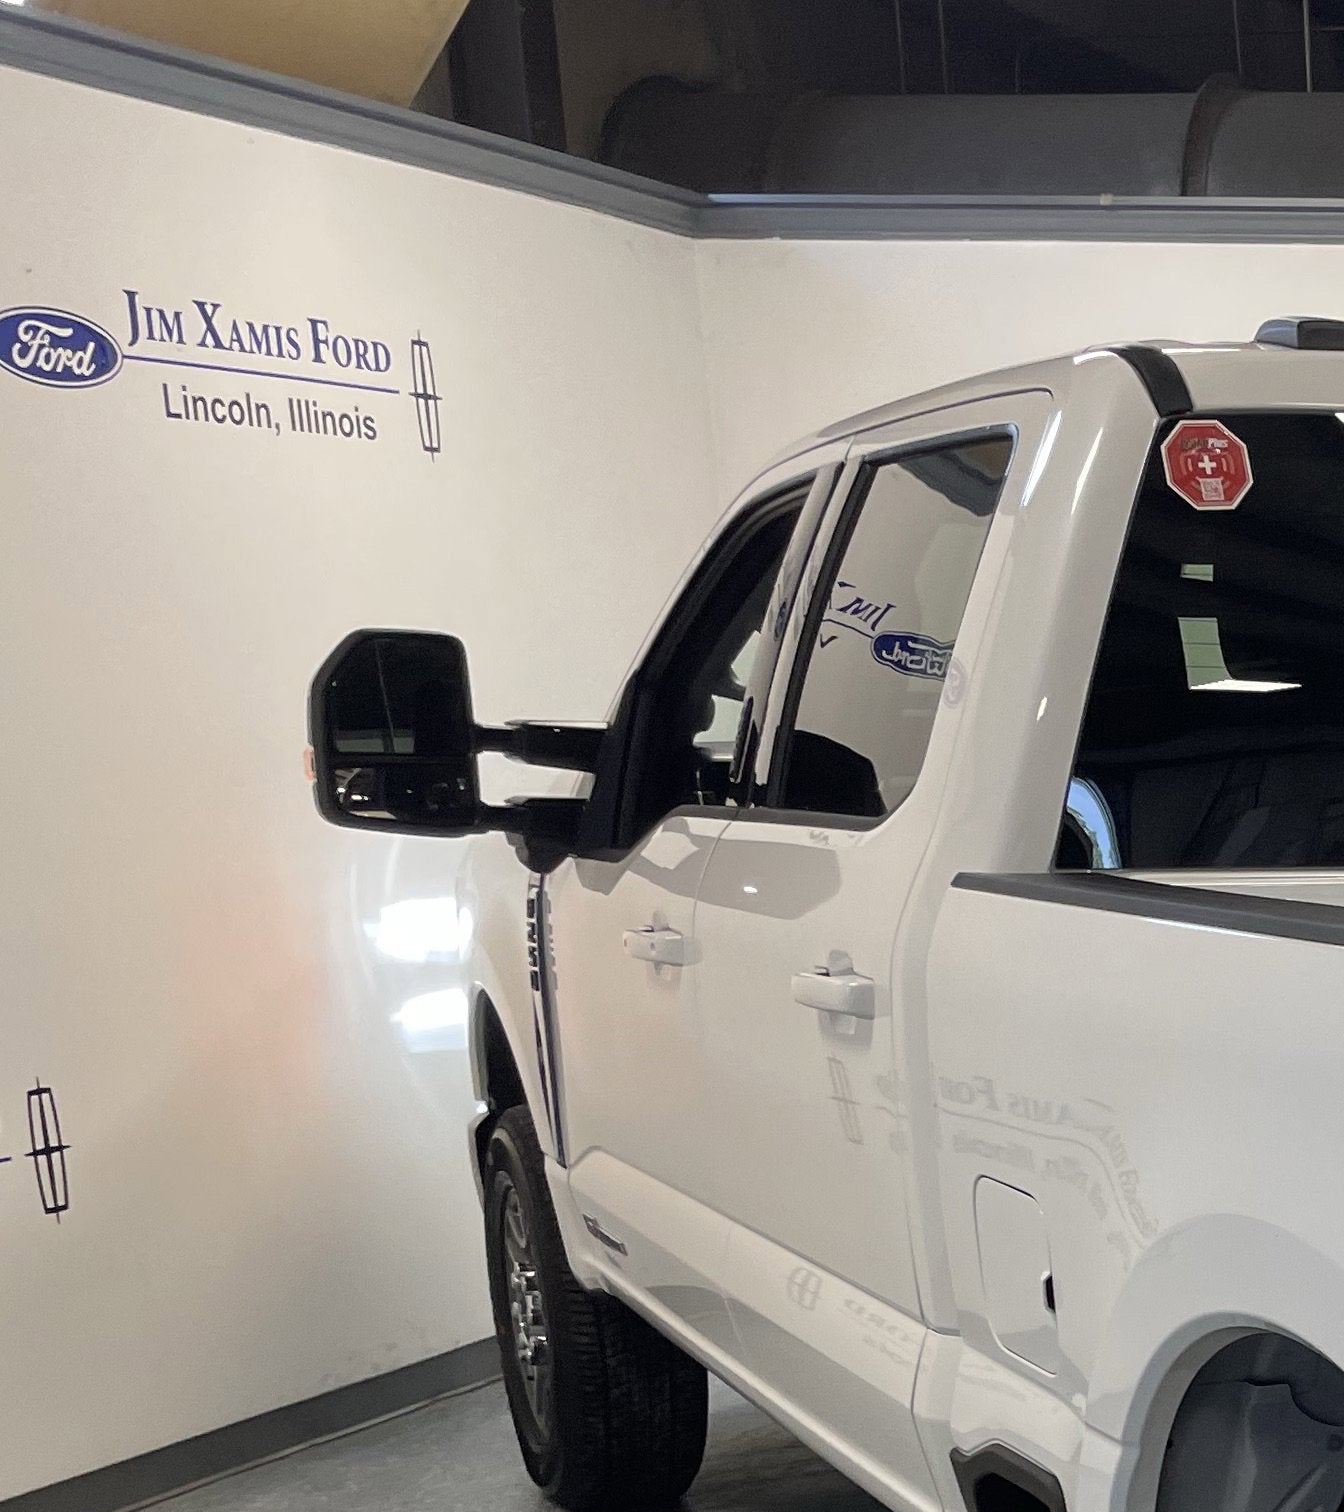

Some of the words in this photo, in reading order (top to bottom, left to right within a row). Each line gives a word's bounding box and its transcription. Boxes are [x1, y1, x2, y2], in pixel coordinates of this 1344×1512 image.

[11, 319, 97, 377] Ford
[122, 288, 187, 347] JIM
[192, 299, 302, 361] XAMIS
[306, 317, 392, 373] FORD
[162, 382, 281, 436] Lincoln,
[288, 397, 378, 441] Illinois
